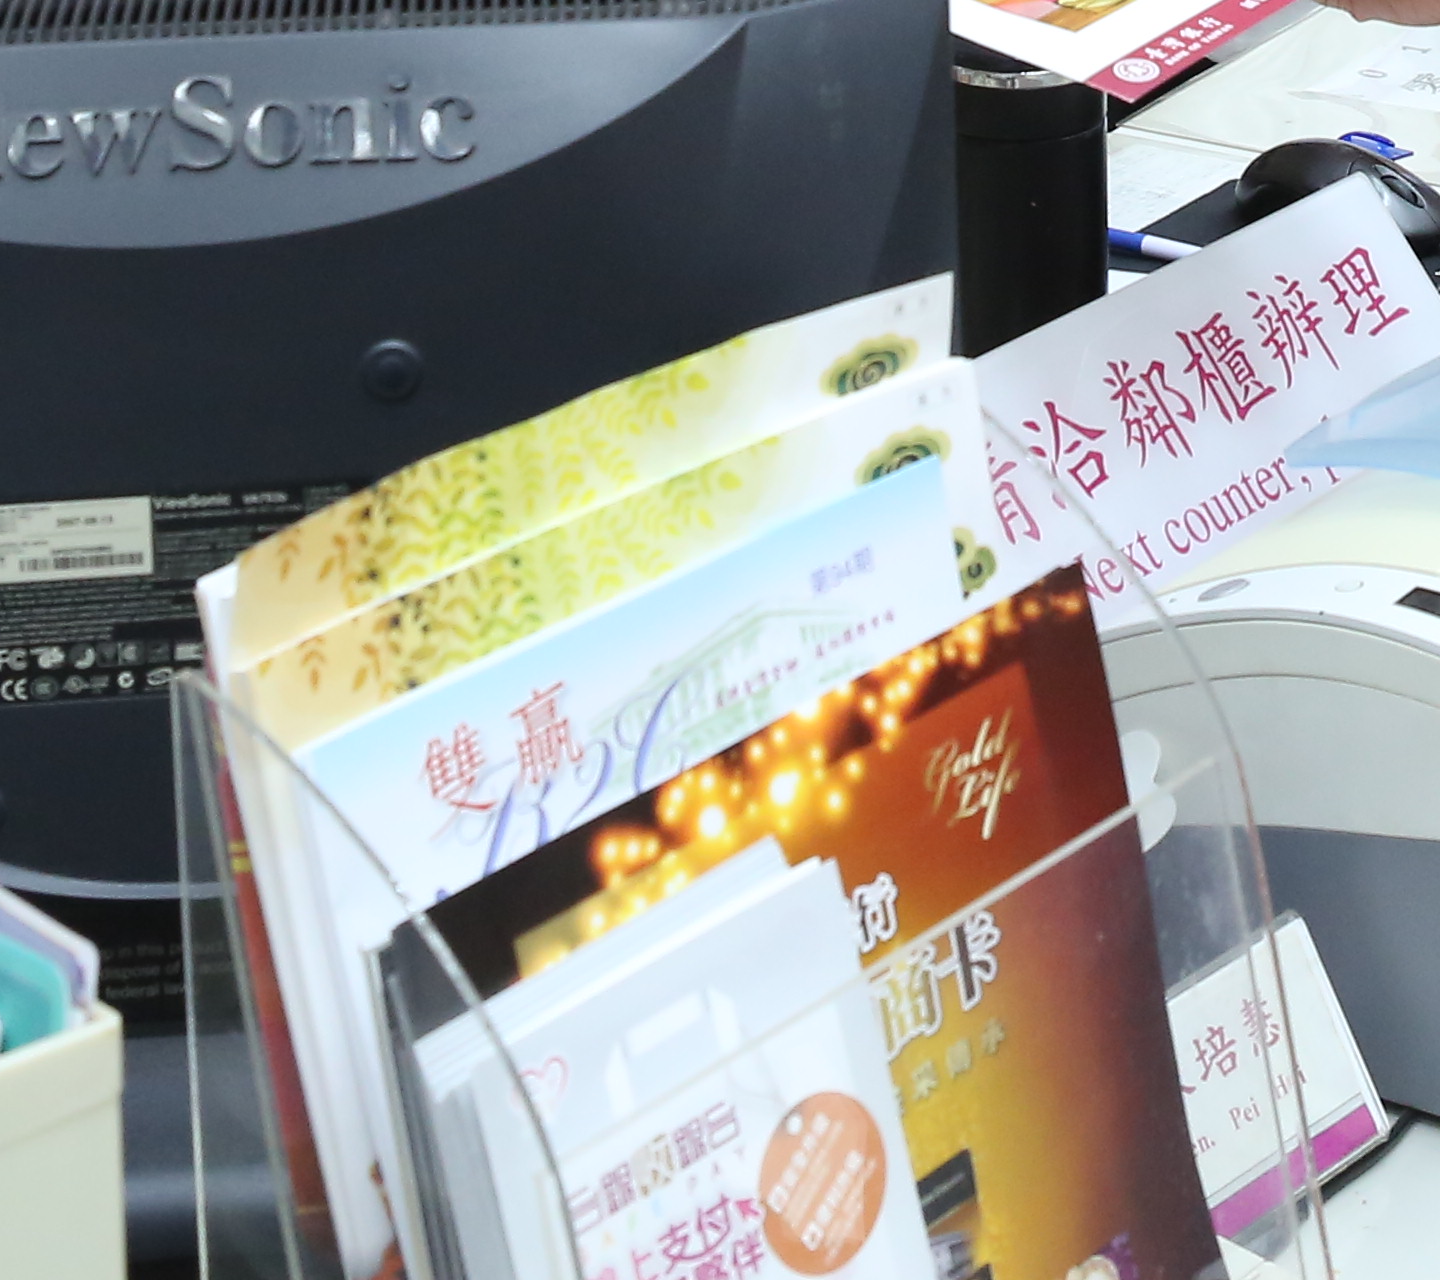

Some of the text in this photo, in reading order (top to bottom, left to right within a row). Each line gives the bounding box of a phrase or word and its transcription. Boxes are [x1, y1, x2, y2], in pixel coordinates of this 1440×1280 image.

[152, 494, 232, 510] ViewSonic
[1075, 448, 1312, 603] Next counter,
[423, 680, 585, 812] 雙贏
[1180, 998, 1281, 1095] 培慧
[1228, 1097, 1261, 1130] Pei
